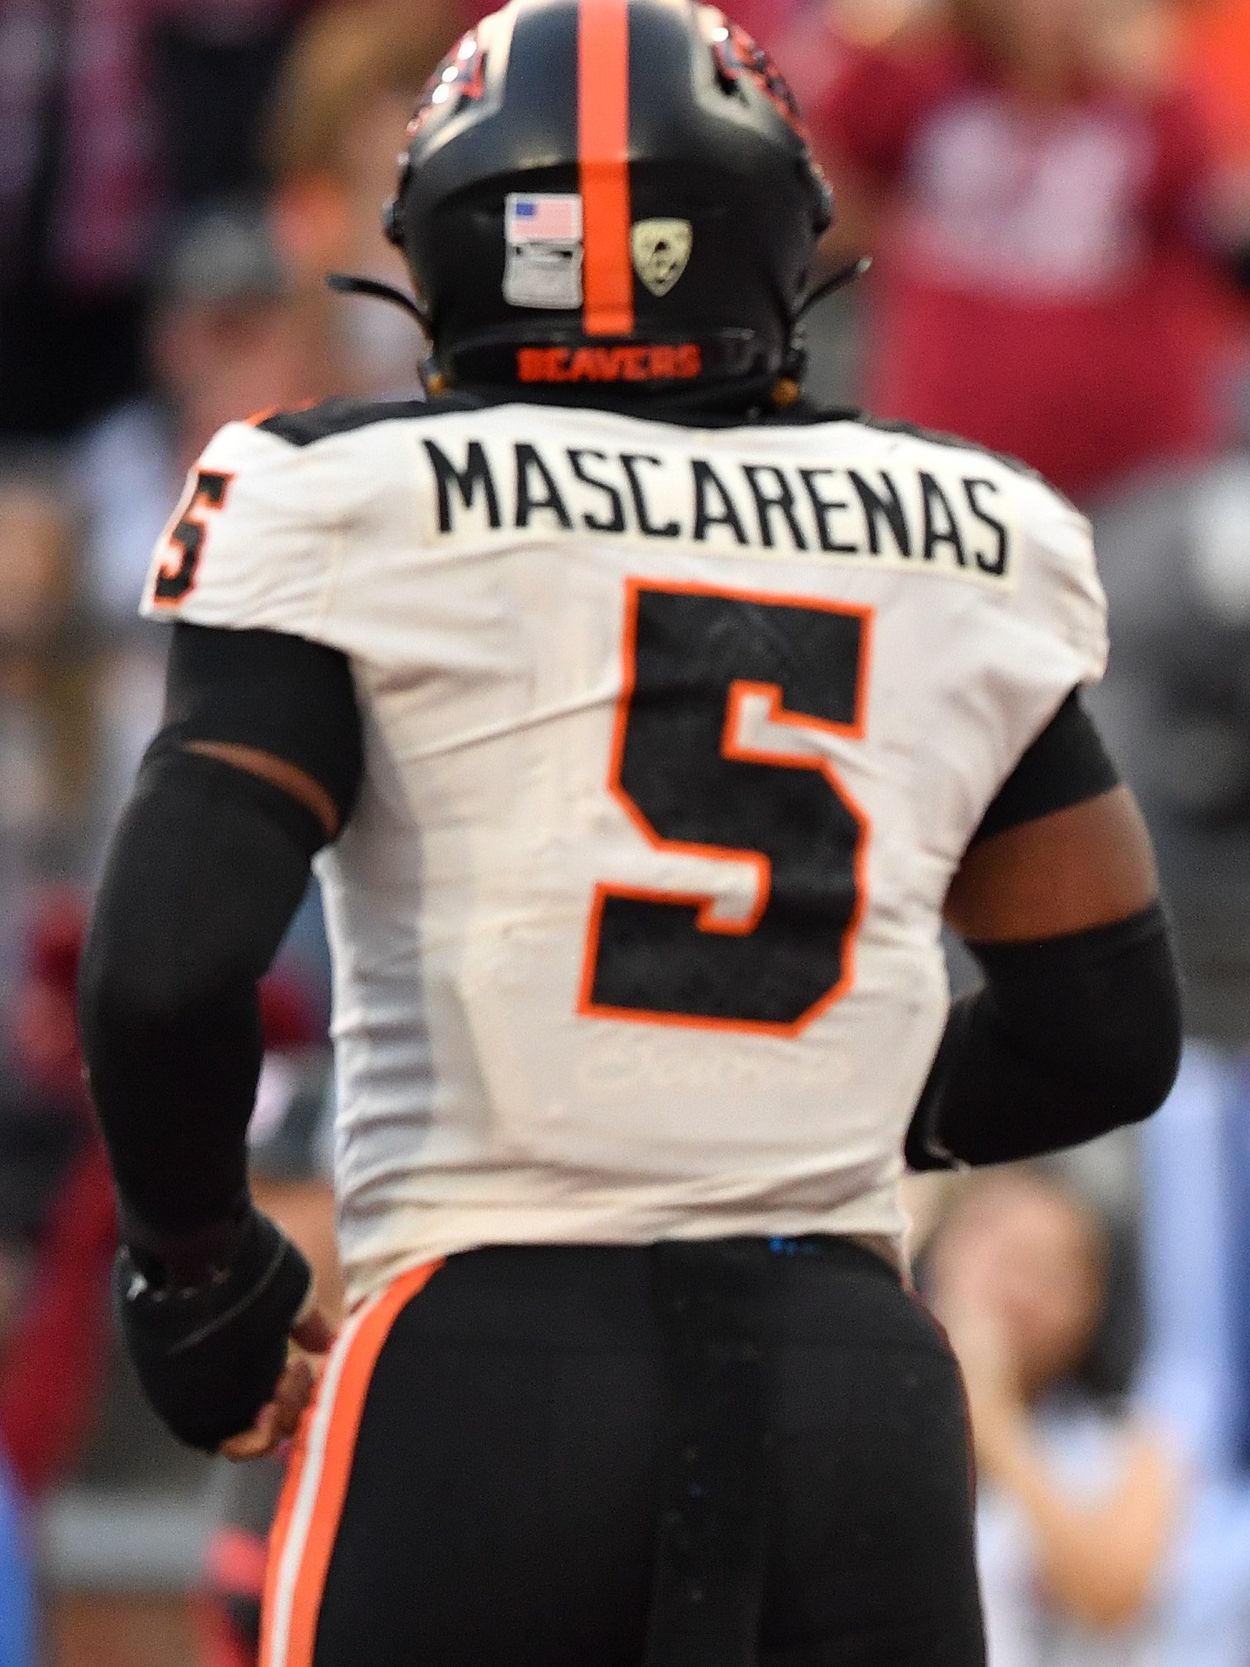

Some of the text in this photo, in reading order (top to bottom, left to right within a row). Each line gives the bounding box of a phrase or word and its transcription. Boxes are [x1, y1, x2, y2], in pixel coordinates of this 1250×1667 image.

[518, 344, 700, 383] BEAVERS
[154, 468, 236, 607] 5
[423, 438, 1009, 576] MASCARENAS
[577, 577, 874, 1038] 5
